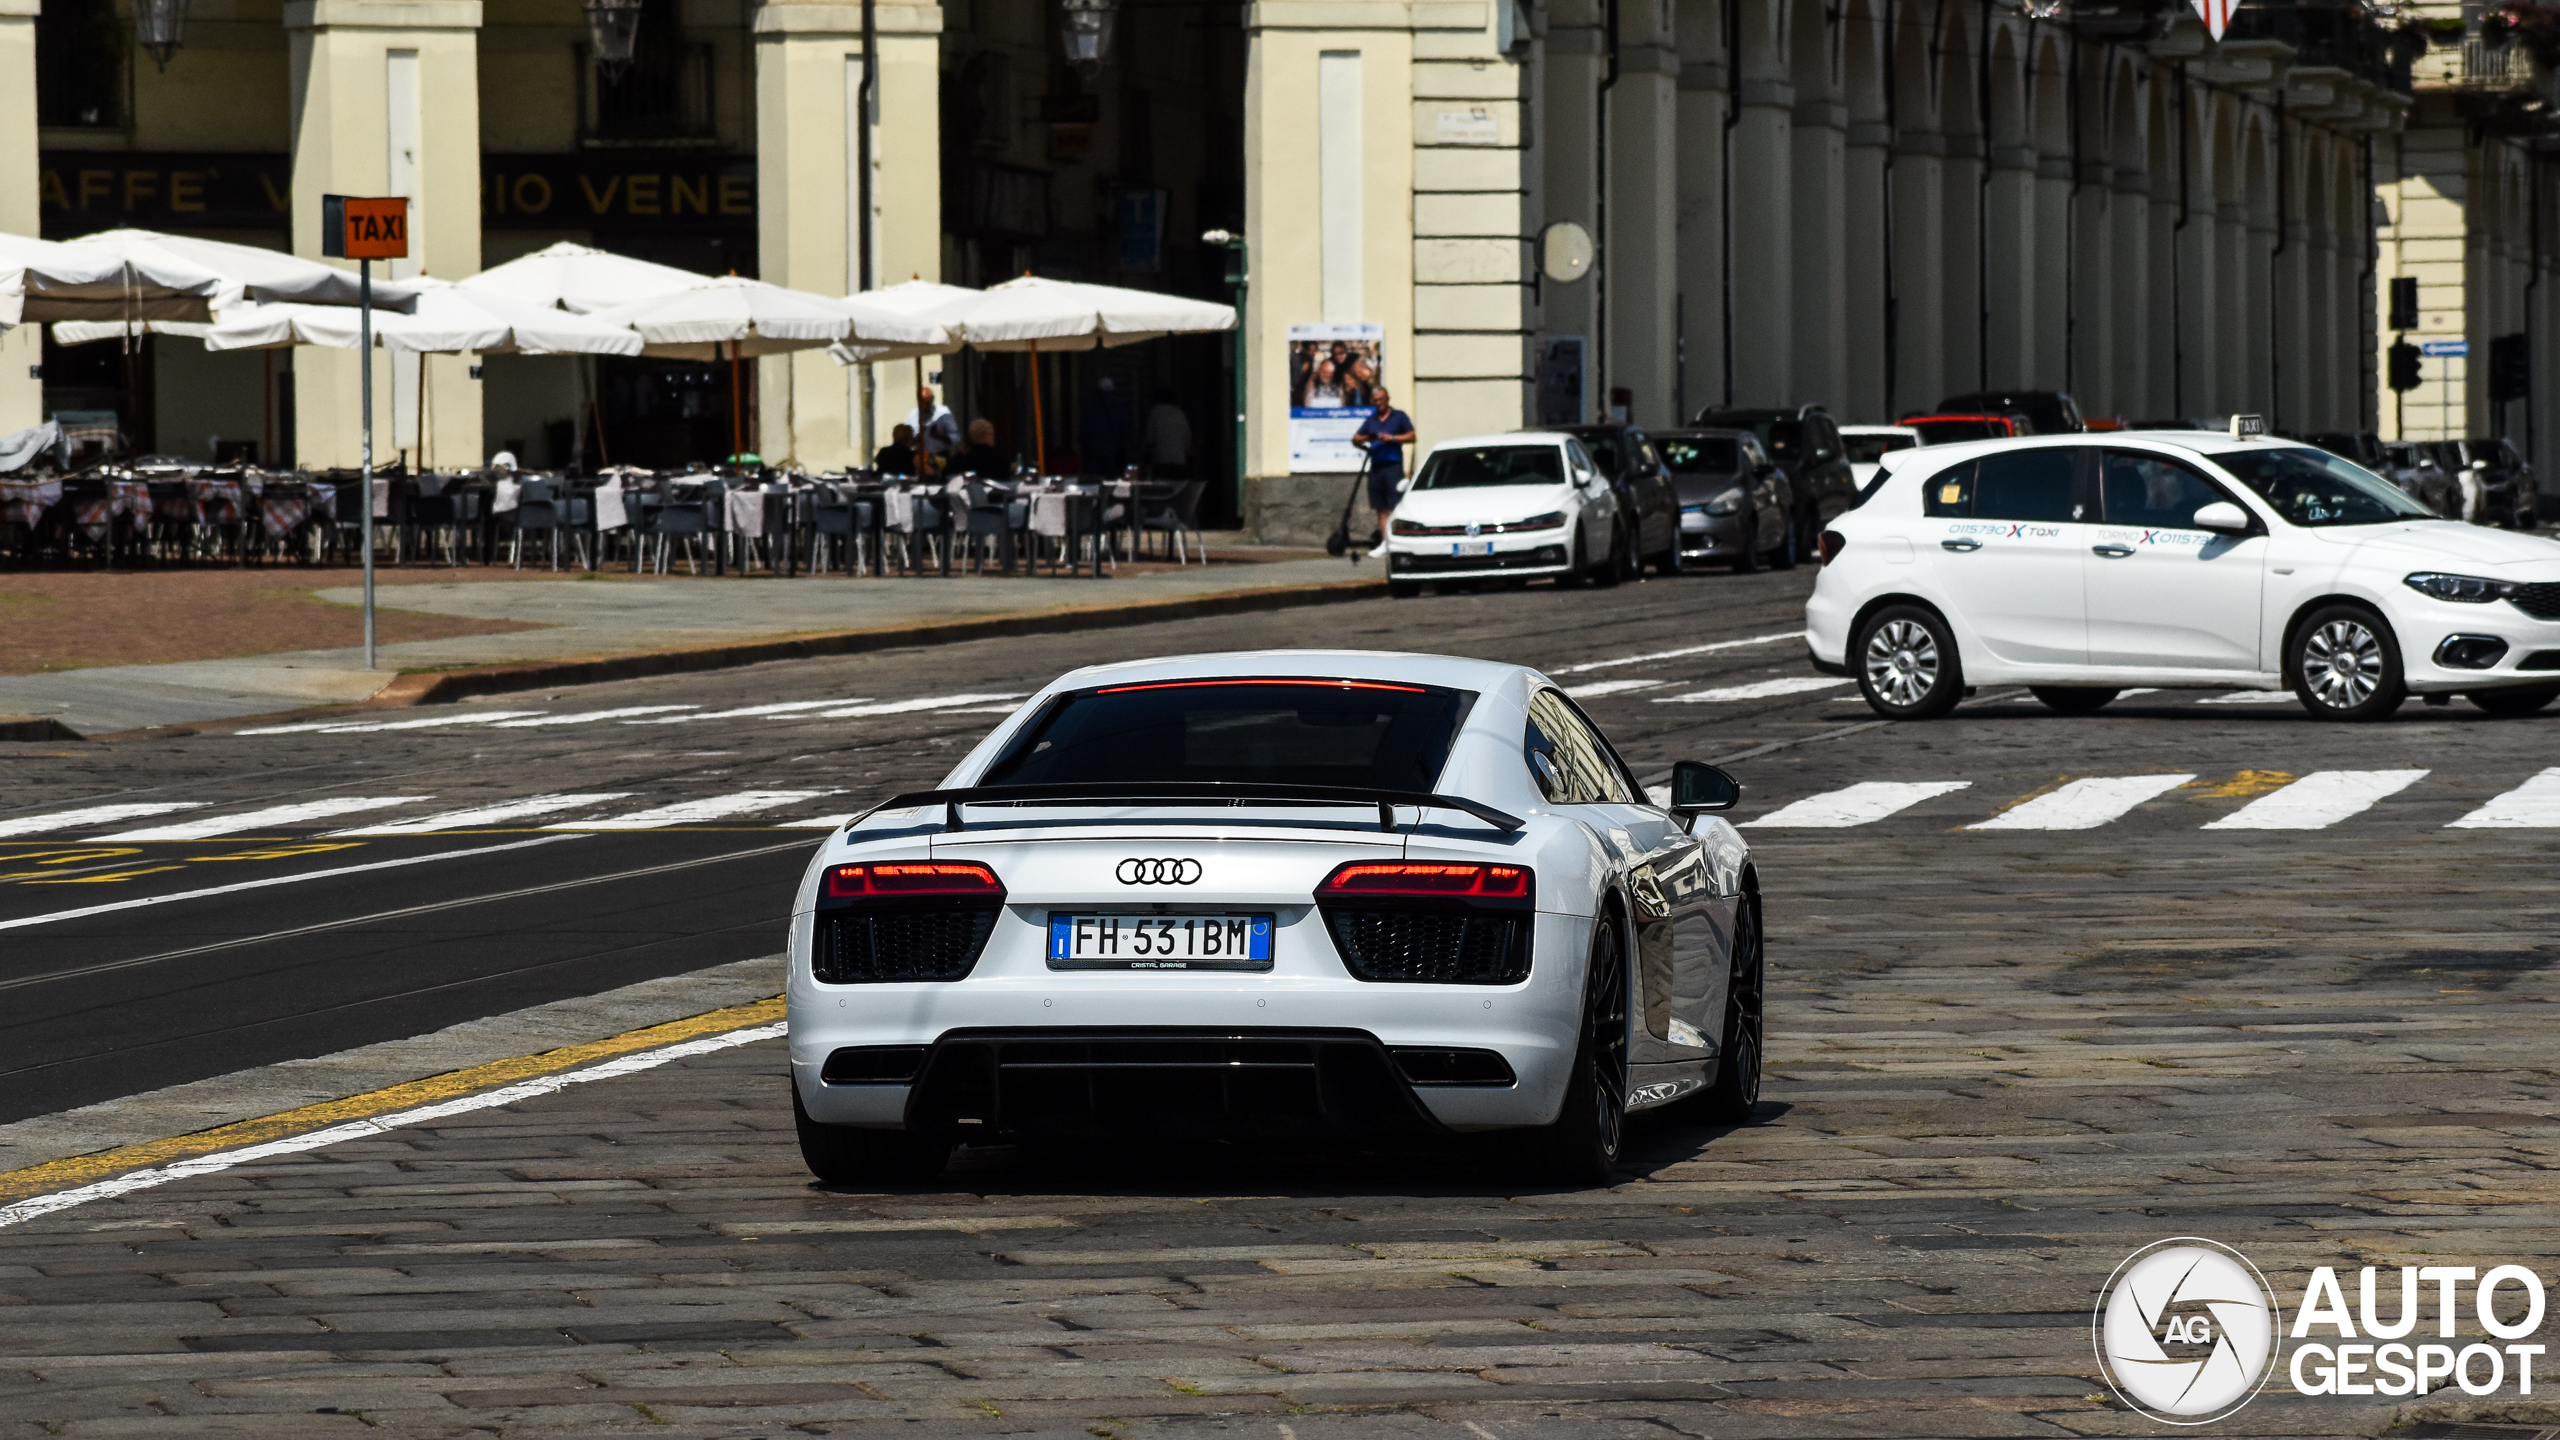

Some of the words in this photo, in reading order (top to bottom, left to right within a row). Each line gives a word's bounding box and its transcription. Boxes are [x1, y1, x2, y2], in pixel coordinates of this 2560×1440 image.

[481, 173, 552, 215] IO
[579, 174, 753, 215] VENE
[349, 214, 403, 242] TAXI
[2238, 418, 2260, 433] TAXI
[1948, 524, 2007, 536] 0115730
[2097, 530, 2139, 542] TORINO
[1075, 919, 1118, 955] FH
[1133, 920, 1246, 956] 531BM
